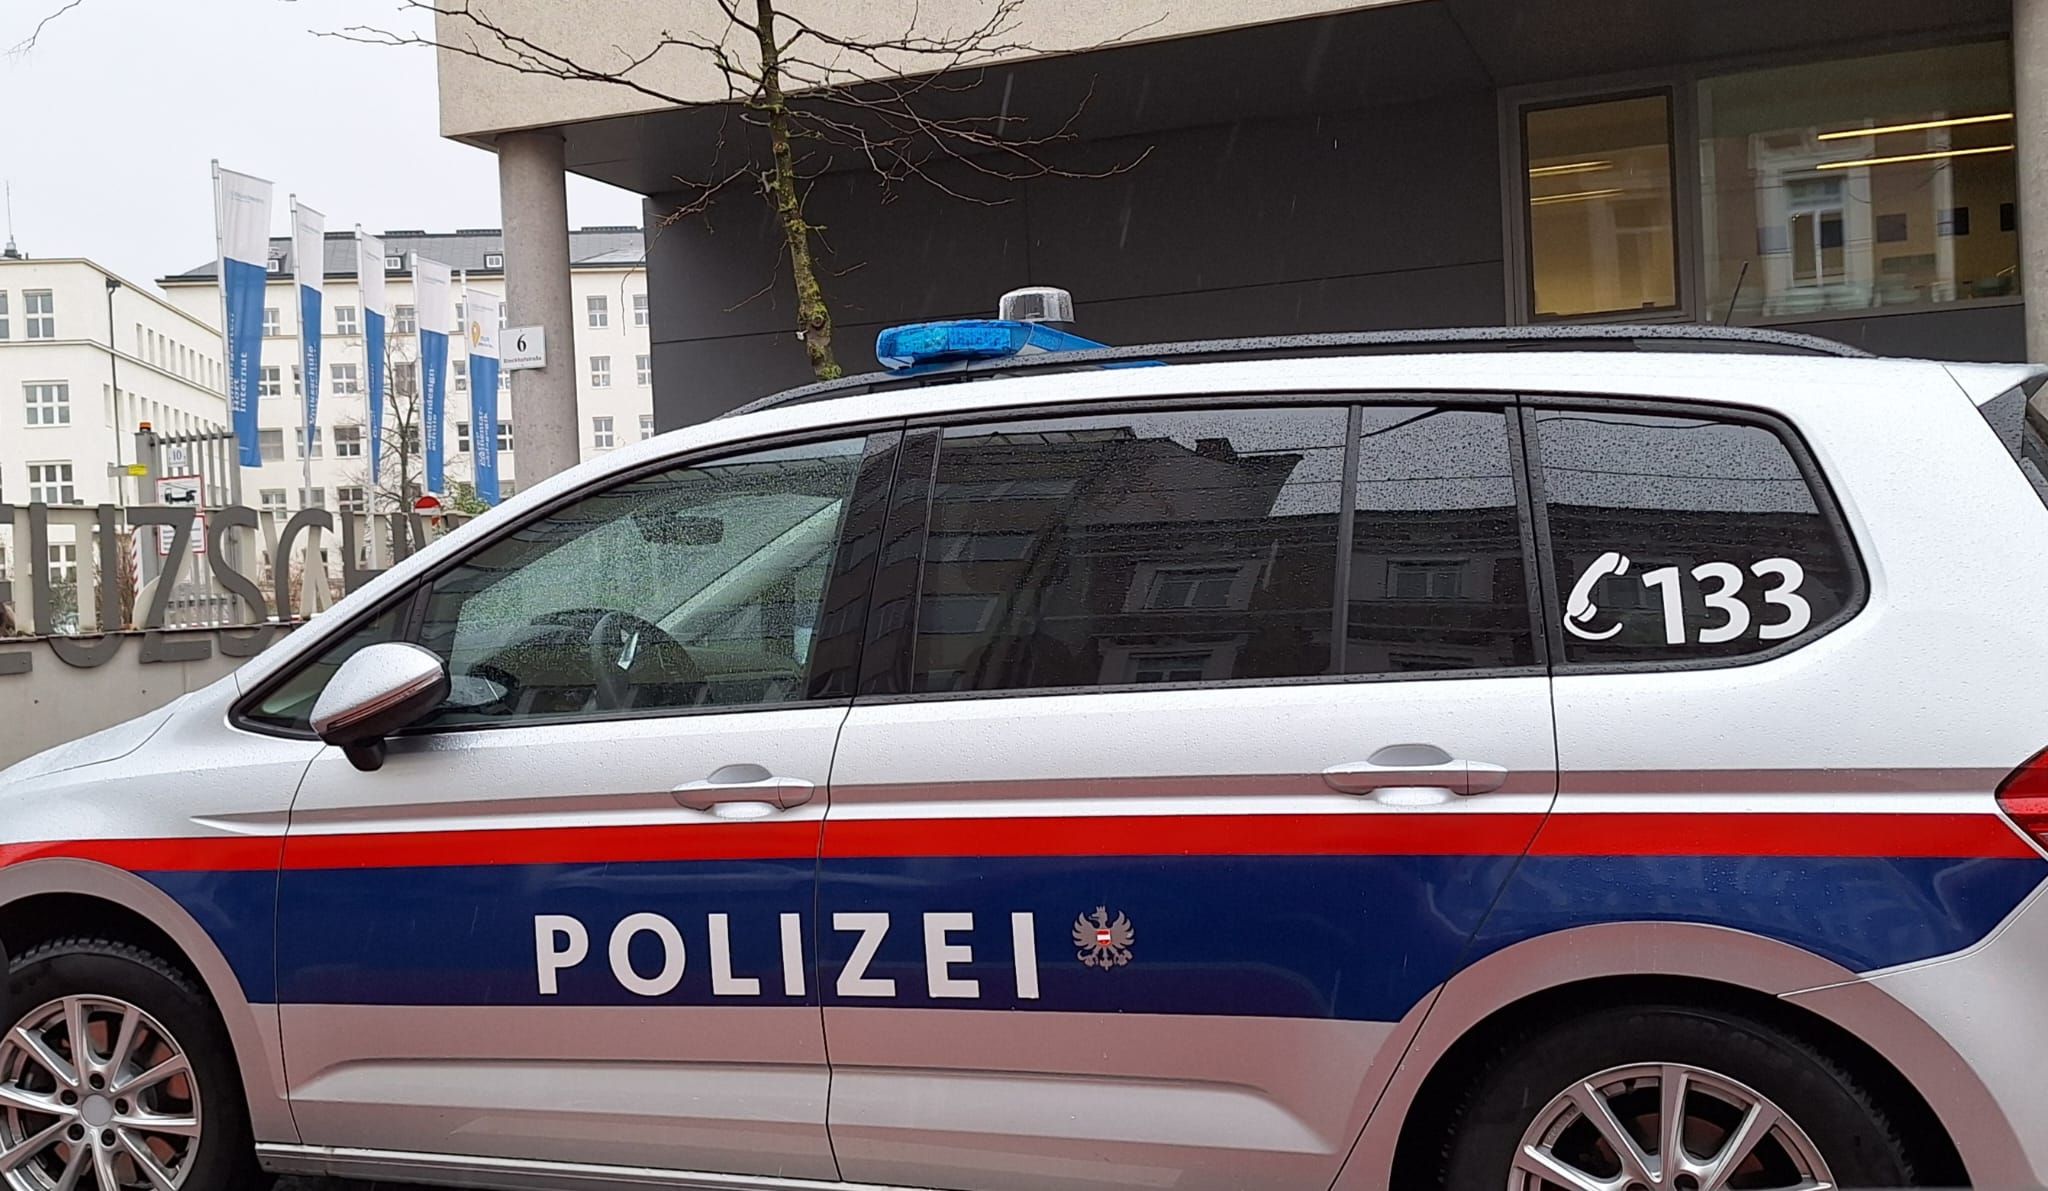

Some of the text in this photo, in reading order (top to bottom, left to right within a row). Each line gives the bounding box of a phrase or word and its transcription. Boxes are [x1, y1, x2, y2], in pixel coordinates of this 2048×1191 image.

[517, 333, 527, 353] 6
[239, 352, 248, 413] Internat
[173, 449, 183, 461] 10
[1641, 557, 1812, 645] 133
[534, 912, 1040, 999] POLIZEI
